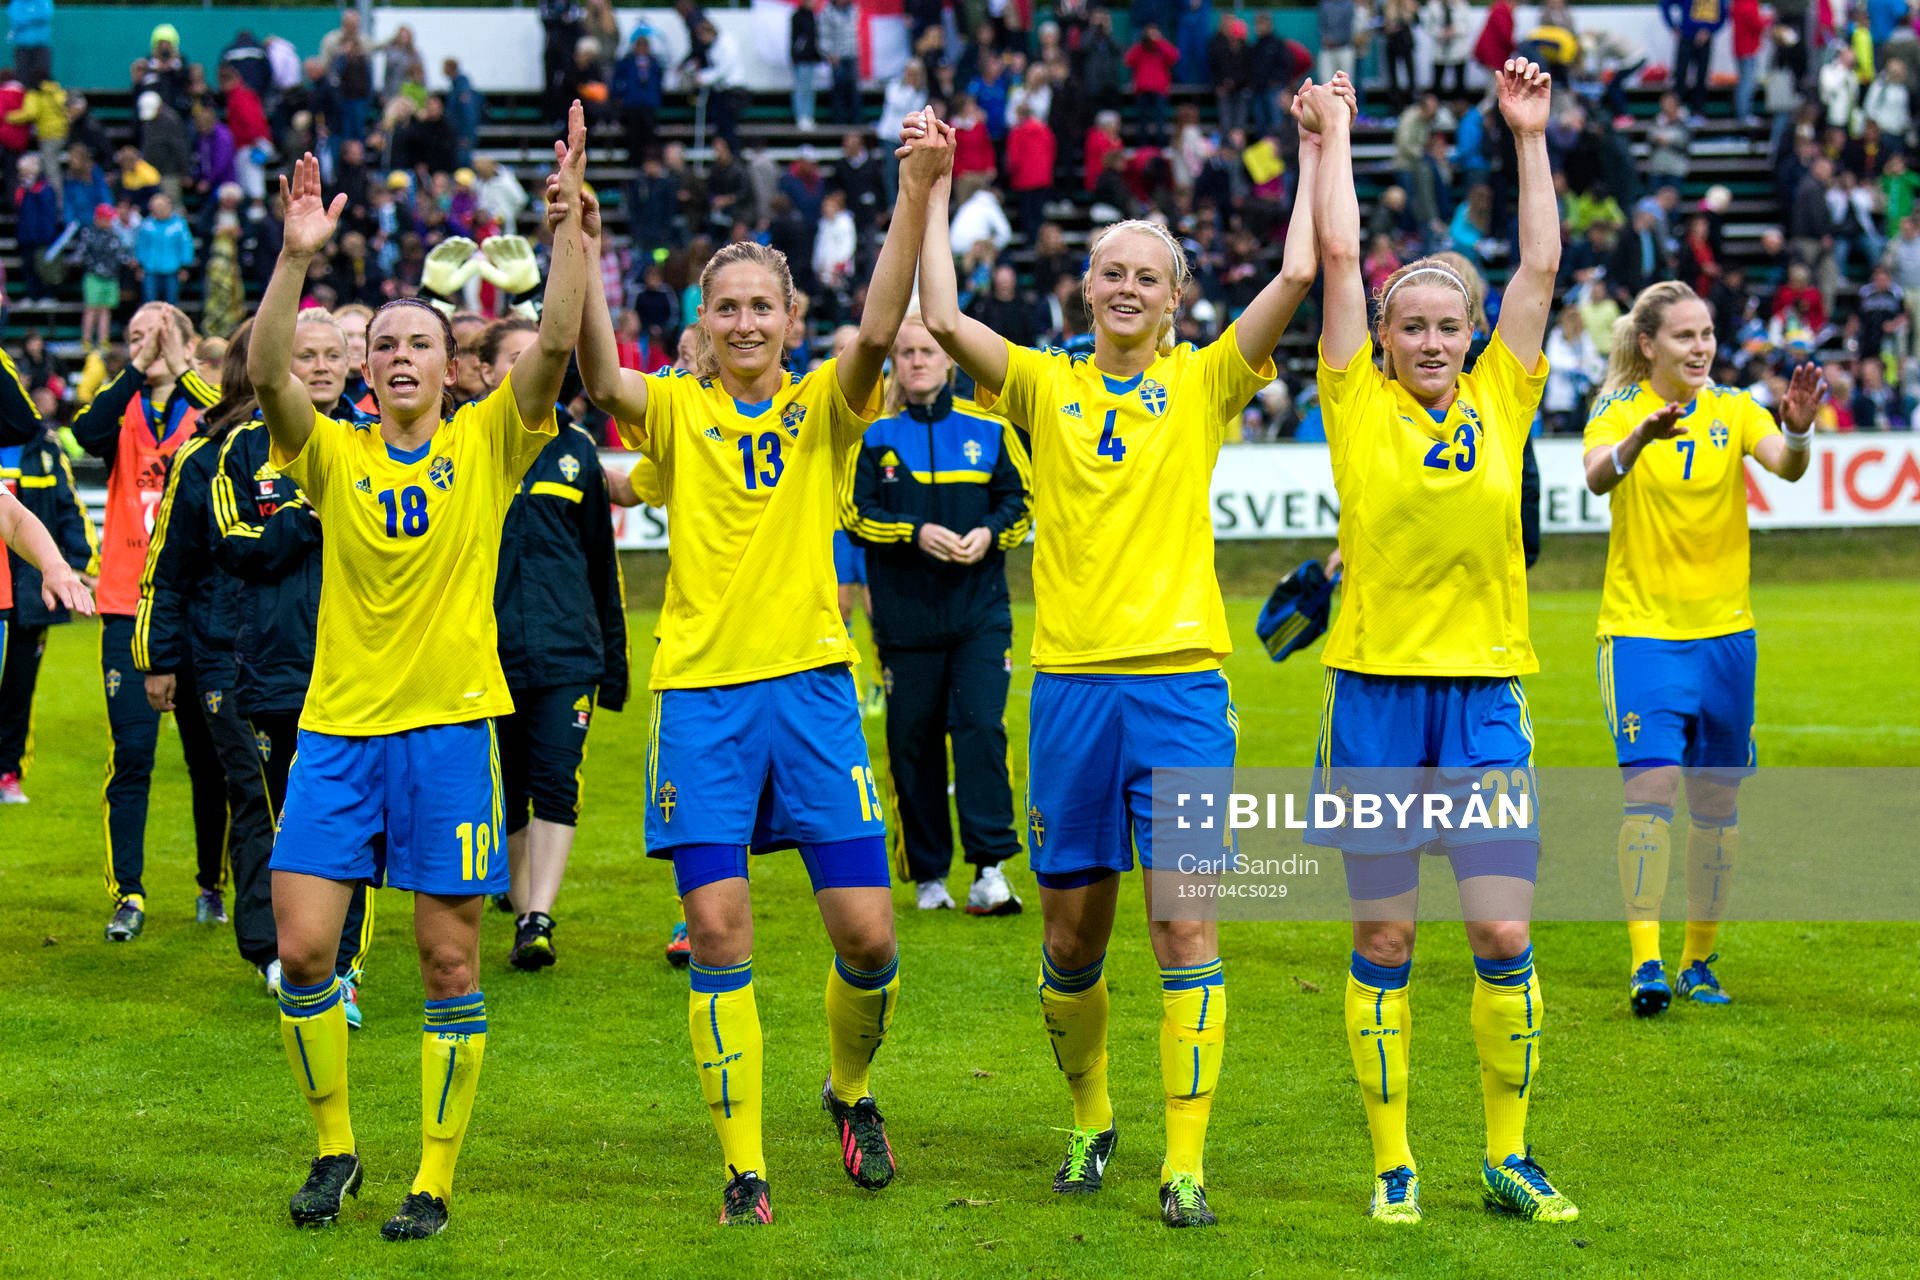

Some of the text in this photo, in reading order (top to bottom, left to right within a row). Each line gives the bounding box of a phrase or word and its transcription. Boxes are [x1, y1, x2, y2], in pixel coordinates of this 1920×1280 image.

[738, 431, 784, 489] 13
[1097, 409, 1126, 462] 4
[1424, 423, 1476, 472] 23
[1676, 440, 1695, 480] 7
[378, 486, 429, 537] 18
[1215, 486, 1608, 530] SVEN EL
[851, 766, 873, 822] 13
[1482, 769, 1533, 826] 23
[456, 822, 490, 880] 18
